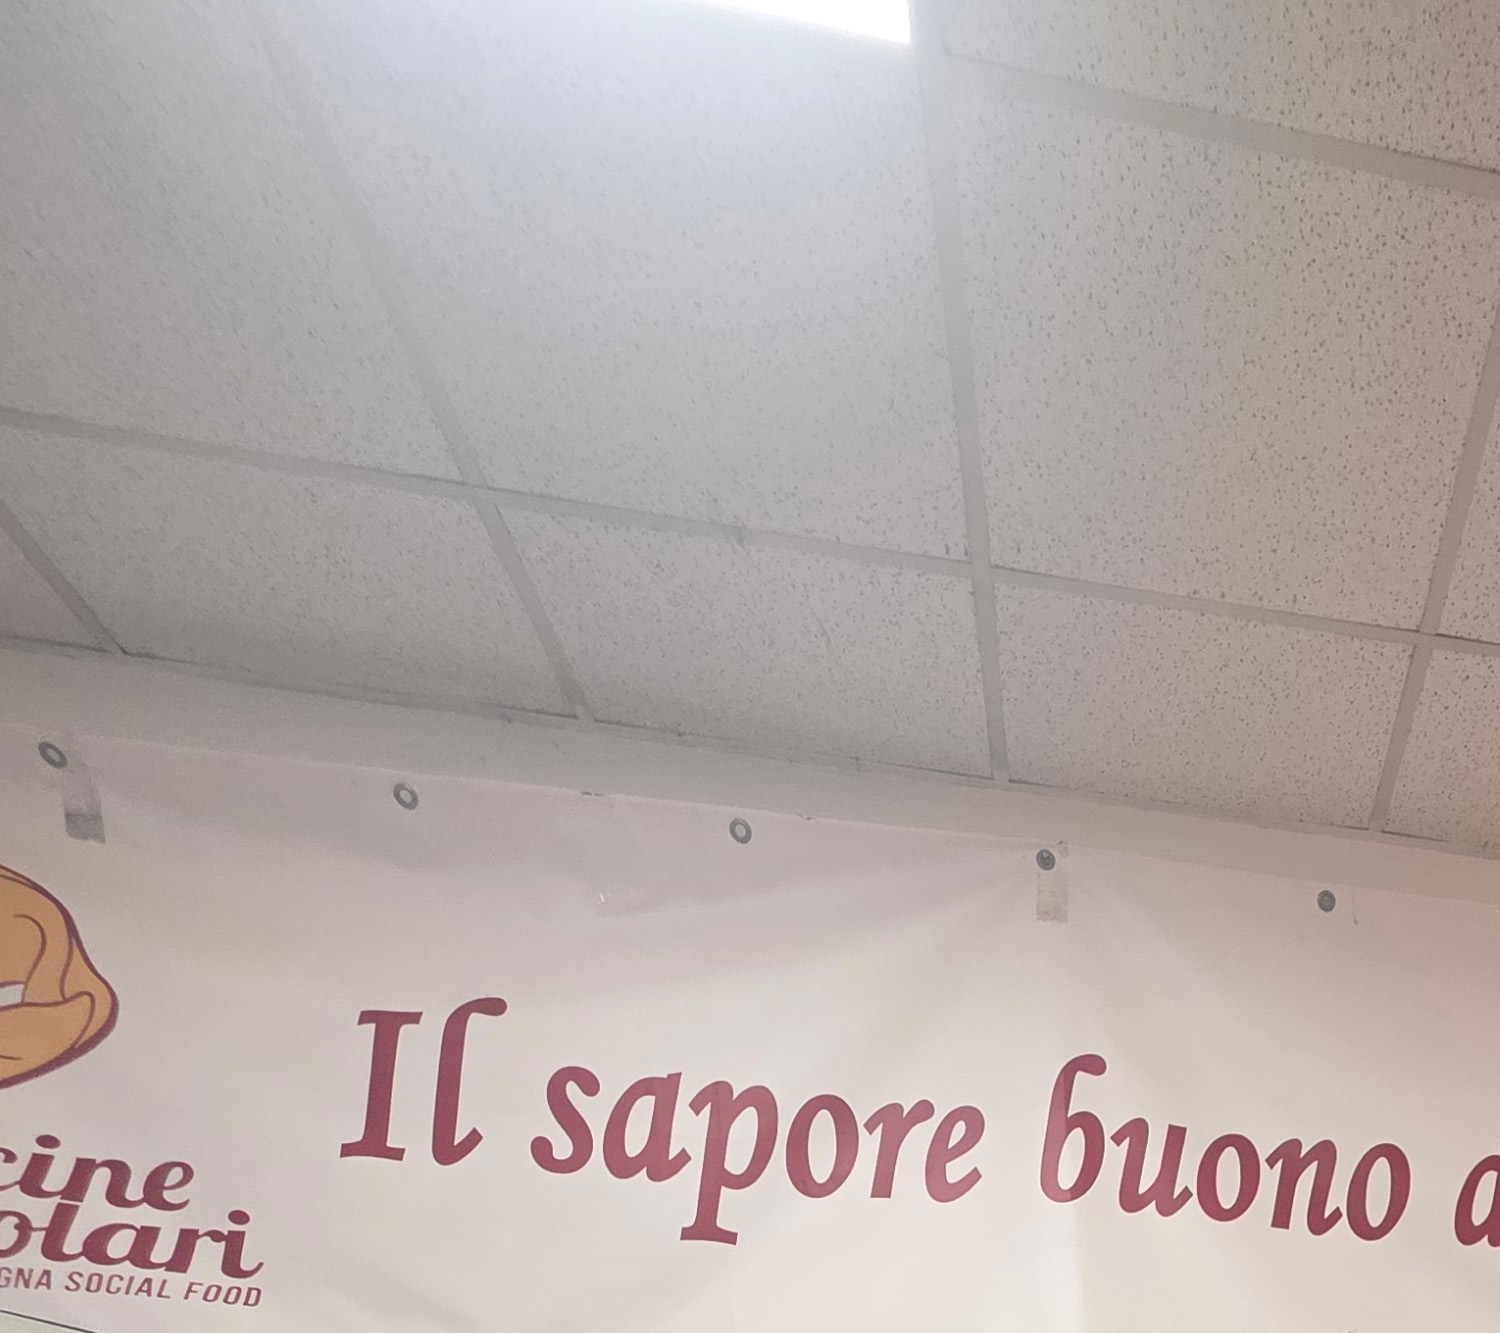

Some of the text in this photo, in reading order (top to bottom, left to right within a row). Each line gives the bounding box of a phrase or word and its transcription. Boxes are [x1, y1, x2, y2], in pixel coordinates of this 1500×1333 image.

[340, 996, 508, 1167] Il
[530, 1065, 987, 1246] sapore
[1039, 1053, 1412, 1242] buono
[64, 1271, 171, 1300] SOCIAL
[183, 1281, 263, 1308] FOOD
